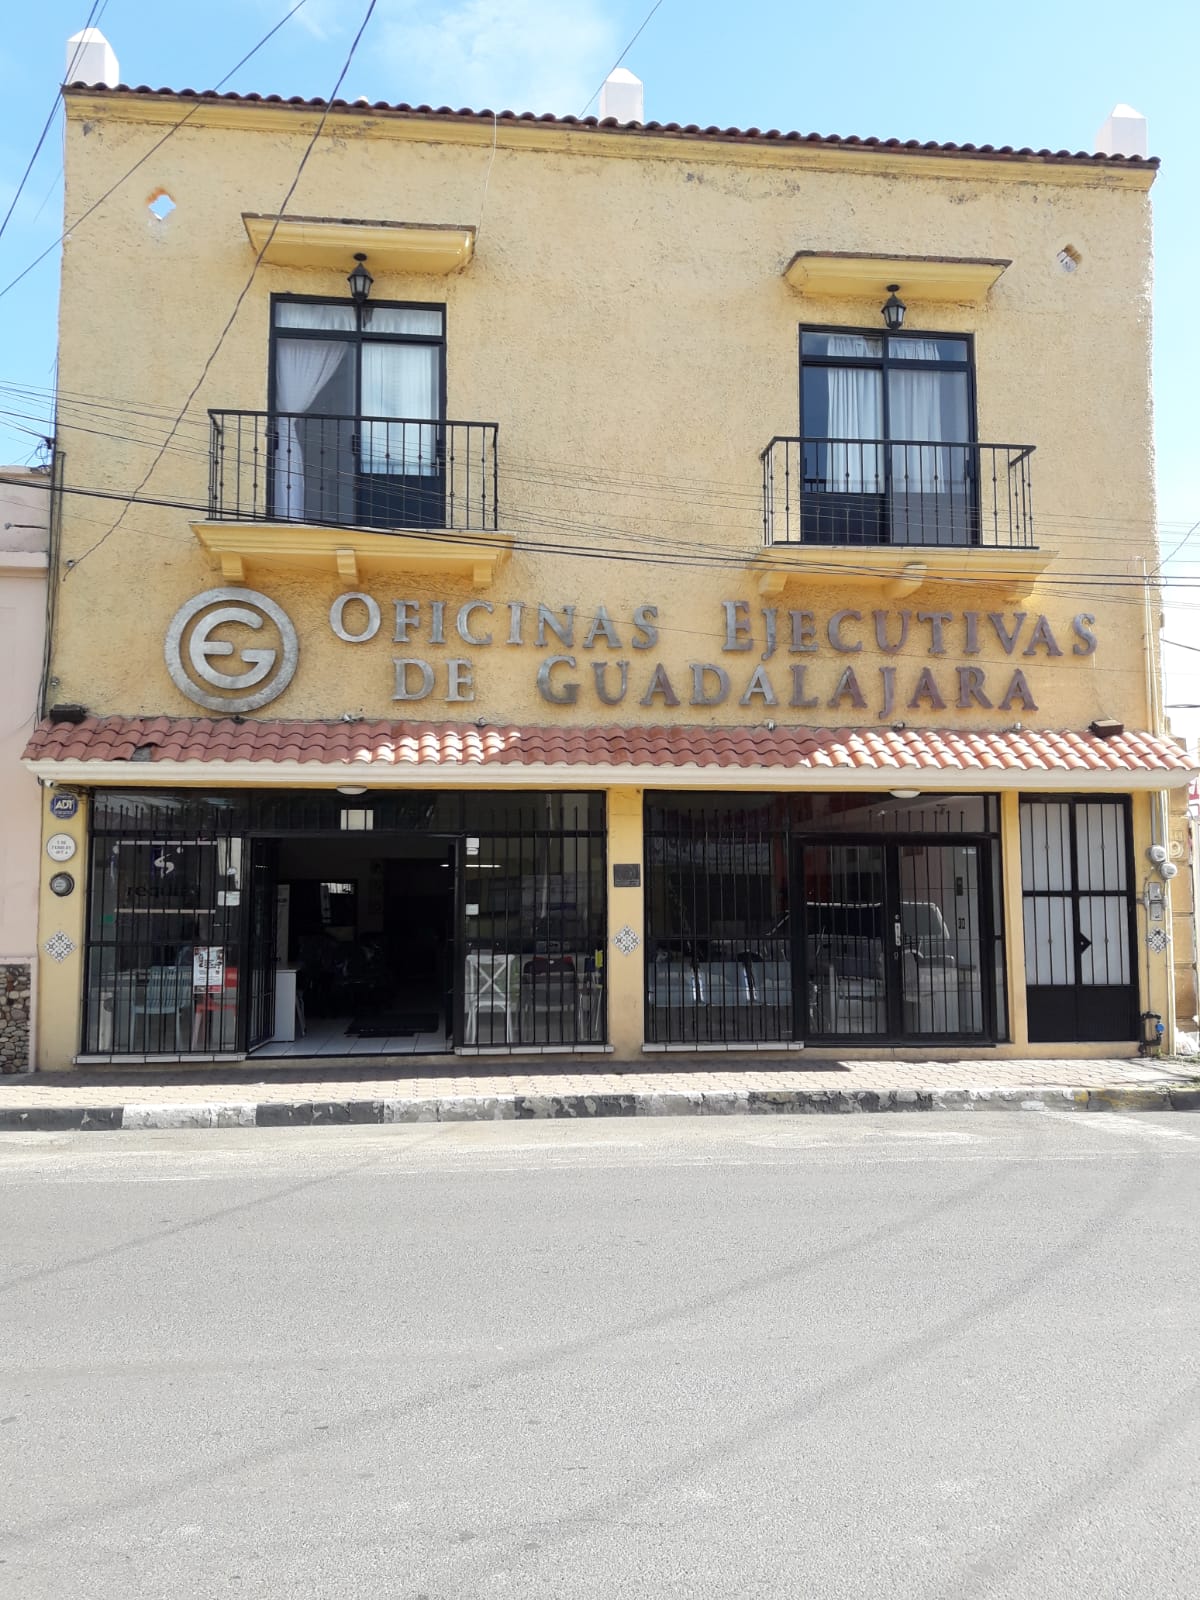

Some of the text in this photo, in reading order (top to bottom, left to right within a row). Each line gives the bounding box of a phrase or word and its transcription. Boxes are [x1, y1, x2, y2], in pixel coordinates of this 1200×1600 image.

[328, 591, 1098, 660] OFICINAS EJECUTIVAS
[391, 655, 1039, 719] DE GUADALAJARA
[55, 799, 74, 810] ADT
